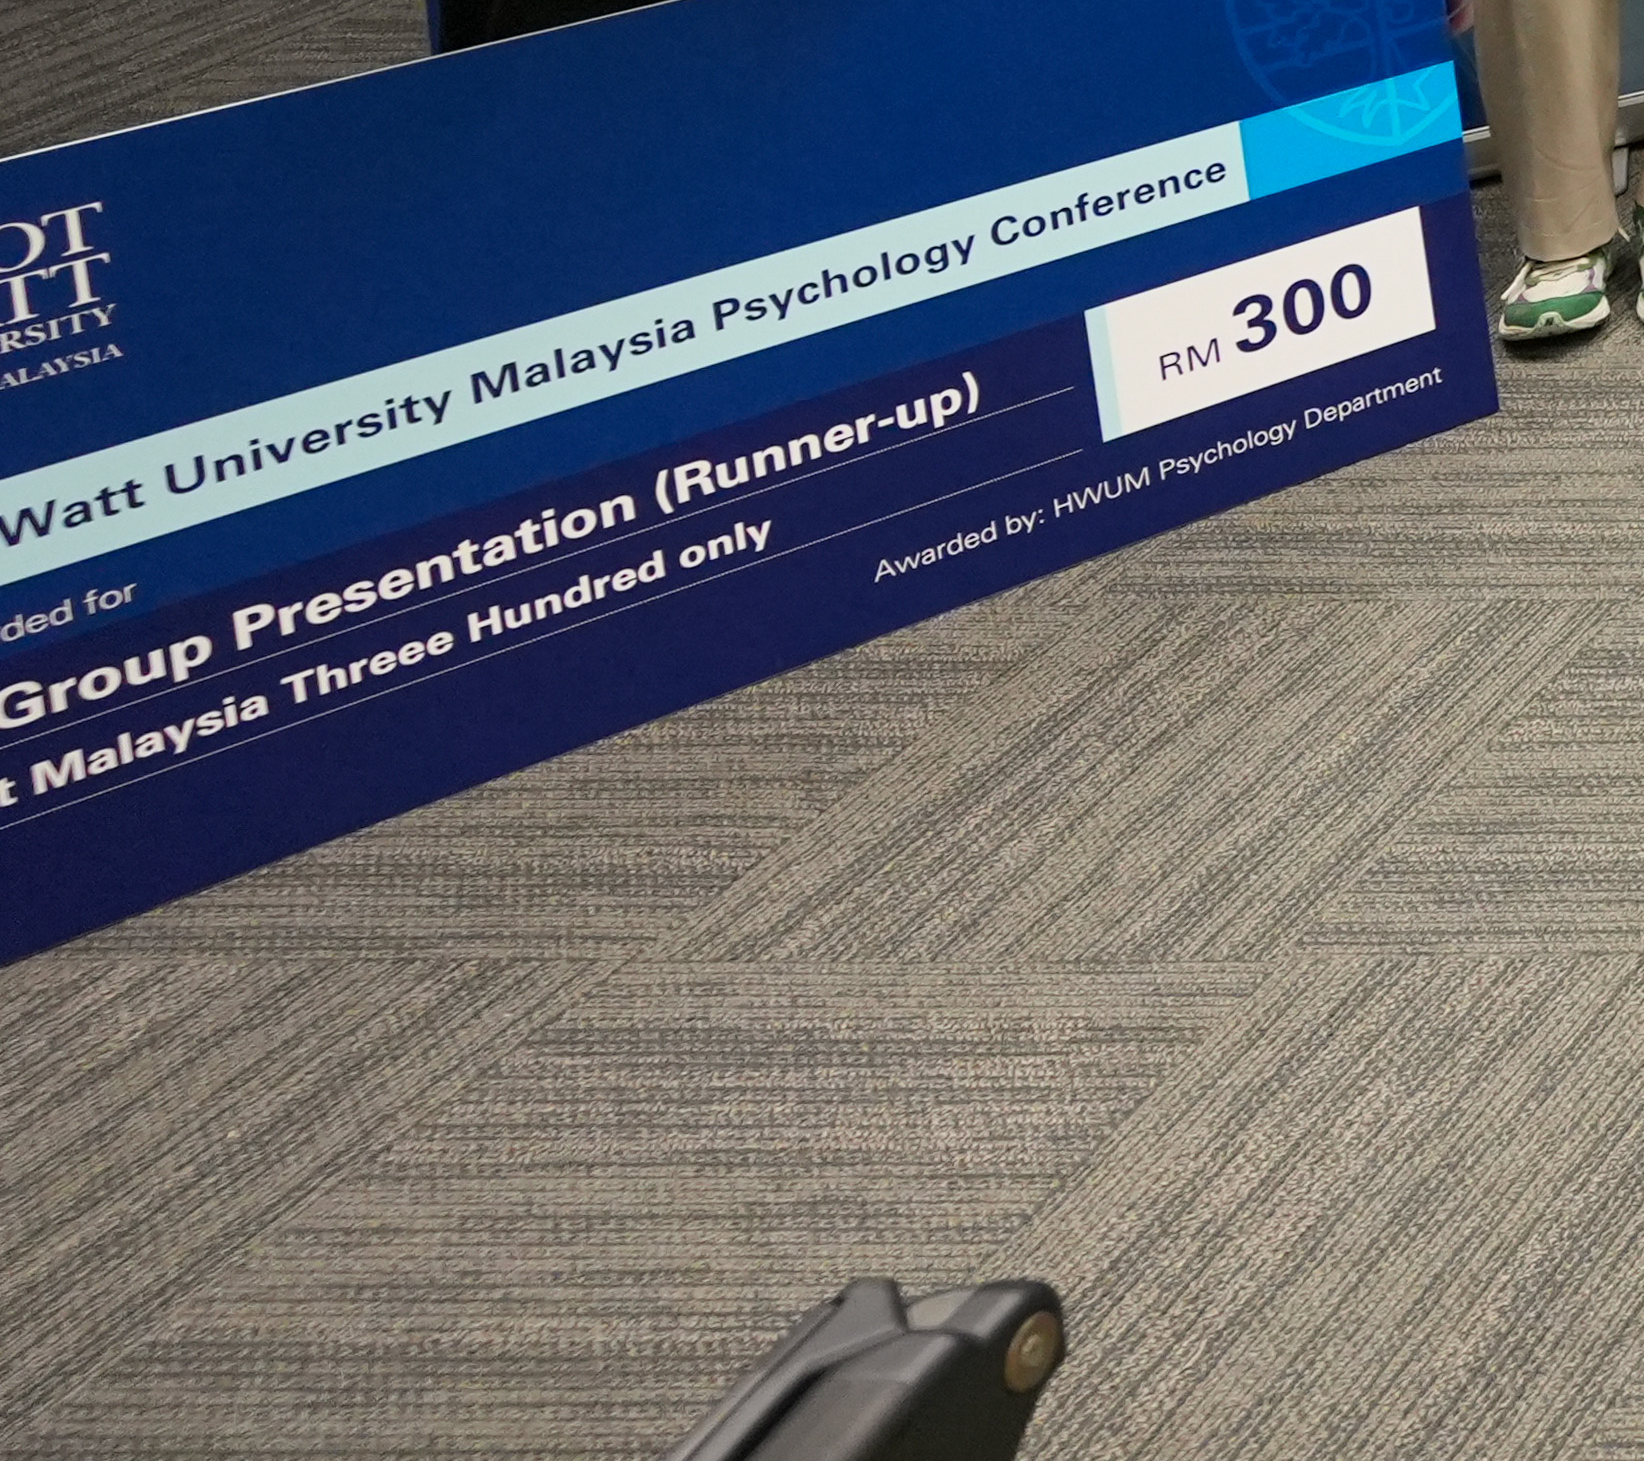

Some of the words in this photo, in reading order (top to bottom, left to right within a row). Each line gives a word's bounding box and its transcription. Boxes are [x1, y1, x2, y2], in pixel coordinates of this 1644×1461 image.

[163, 386, 454, 498] University
[469, 317, 698, 406] Malaysia
[711, 228, 979, 331] Psychology
[989, 157, 1228, 248] Conference
[1157, 338, 1223, 382] RM
[1231, 261, 1374, 355] 300
[0, 632, 212, 730] Group
[231, 491, 637, 653] Presentation
[654, 370, 982, 515] (Runner-up)
[873, 520, 1000, 583] Awarded
[1004, 504, 1045, 538] by:
[1052, 467, 1152, 518] HWUM
[1158, 419, 1298, 481] Psychology
[1302, 367, 1444, 430] Department
[30, 696, 270, 796] Malaysia
[280, 632, 455, 706] Threee
[467, 551, 666, 643] Hundred
[677, 517, 774, 572] only
[83, 580, 138, 619] for
